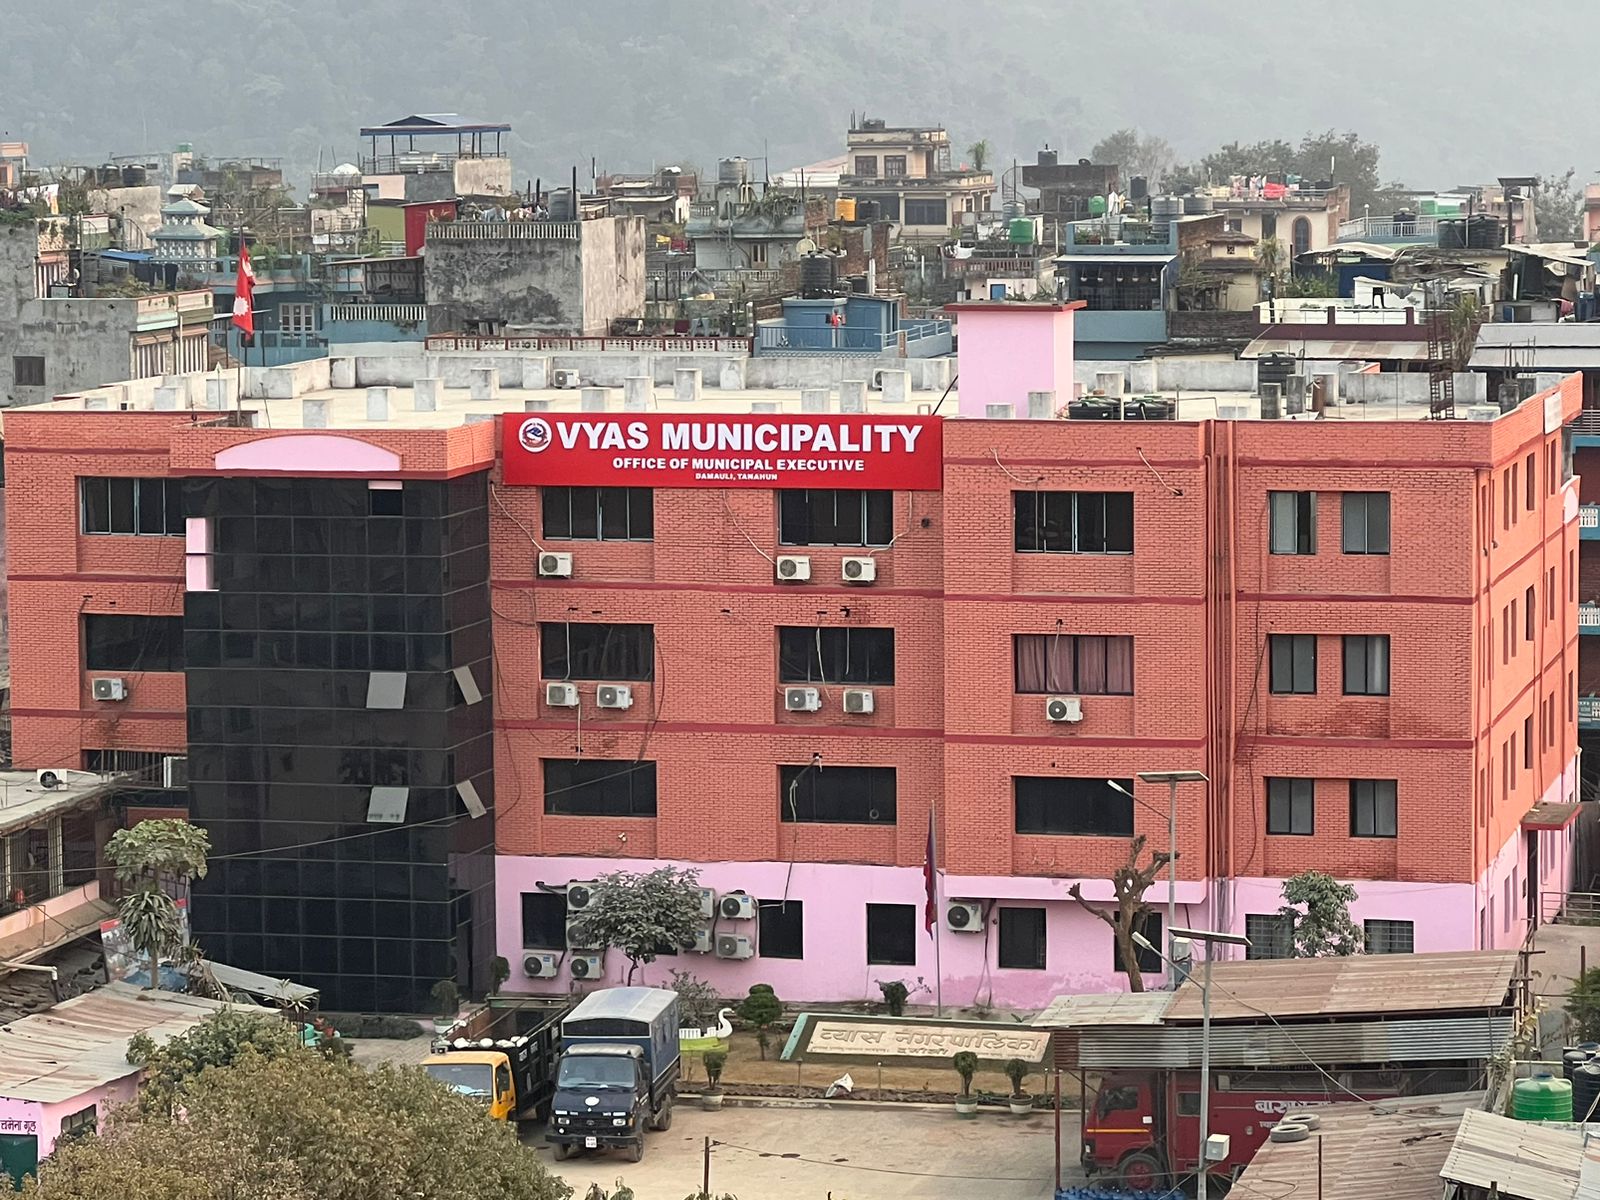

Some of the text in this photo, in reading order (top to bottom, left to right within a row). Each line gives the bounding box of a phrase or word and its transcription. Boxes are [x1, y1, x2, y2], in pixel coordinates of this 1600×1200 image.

[556, 421, 923, 452] VYAS MUNICIPALITY
[612, 457, 865, 471] OFFICE OF MUNICIPAL EXECUTIVE
[695, 472, 736, 480] DAMAULI,
[820, 1028, 1041, 1050] व्यास नगरपालिका
